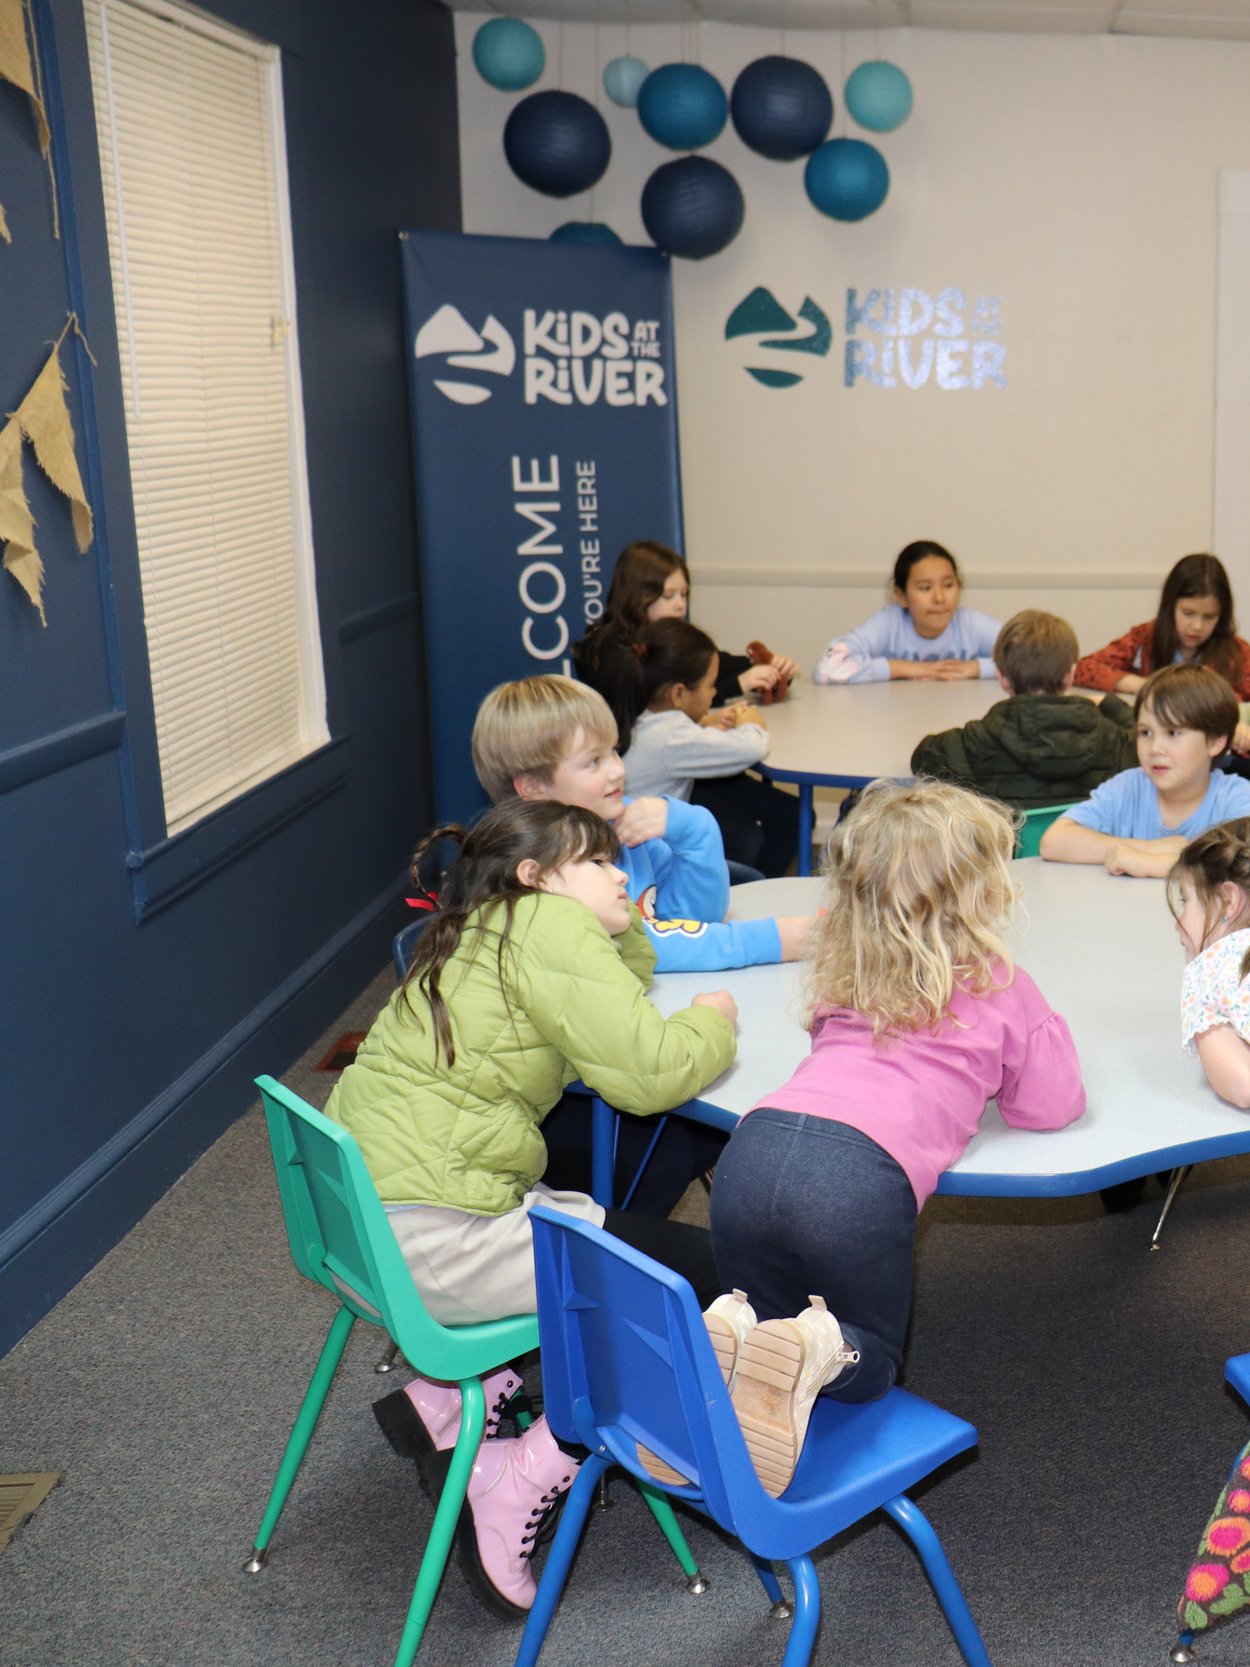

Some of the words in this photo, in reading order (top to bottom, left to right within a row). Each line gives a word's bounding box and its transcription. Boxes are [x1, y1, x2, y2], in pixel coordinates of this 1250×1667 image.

[631, 342, 661, 358] THE
[634, 320, 660, 341] AT
[576, 460, 598, 532] HERE
[511, 454, 571, 678] COME
[580, 539, 604, 625] OU'RE
